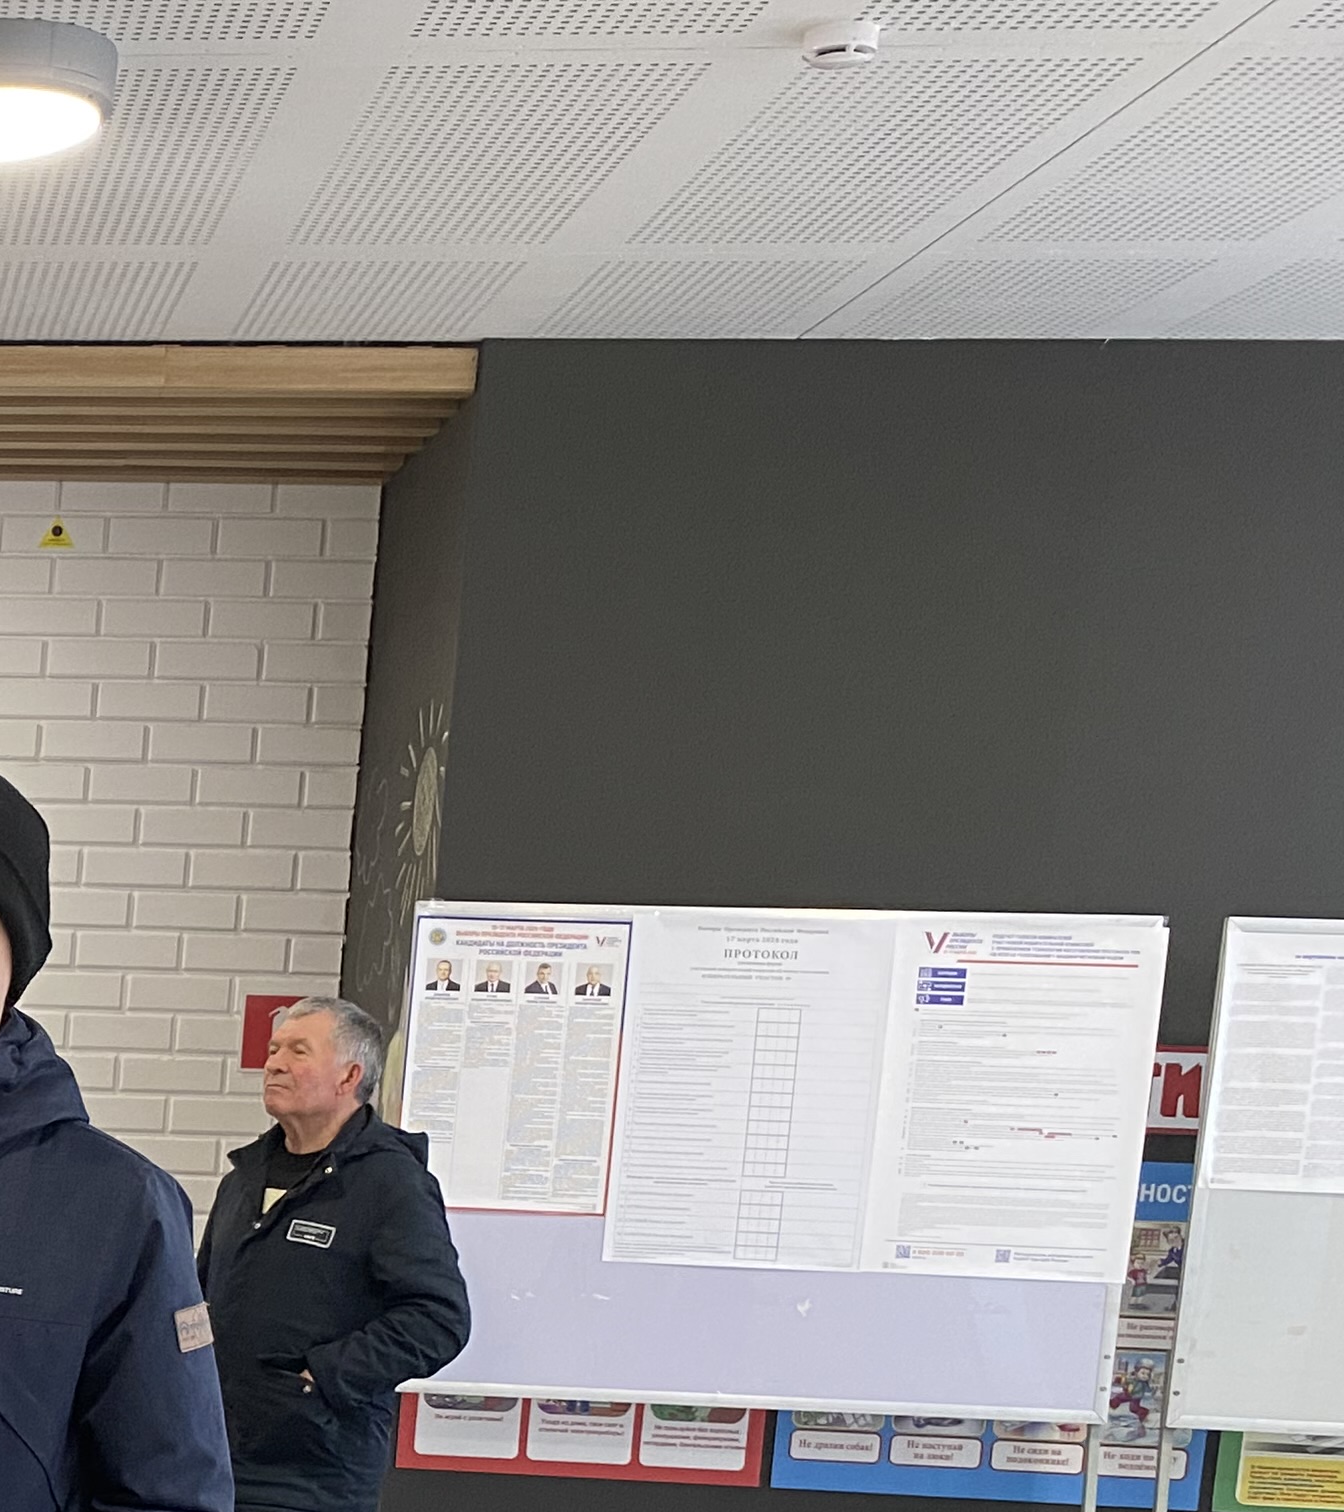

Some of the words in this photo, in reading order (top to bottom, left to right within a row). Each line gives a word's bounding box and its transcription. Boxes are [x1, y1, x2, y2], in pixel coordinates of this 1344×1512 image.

[724, 949, 799, 960] ПРОТОКОЛ
[799, 1439, 812, 1448] Не
[907, 1440, 919, 1449] Не
[1013, 1445, 1025, 1454] Не
